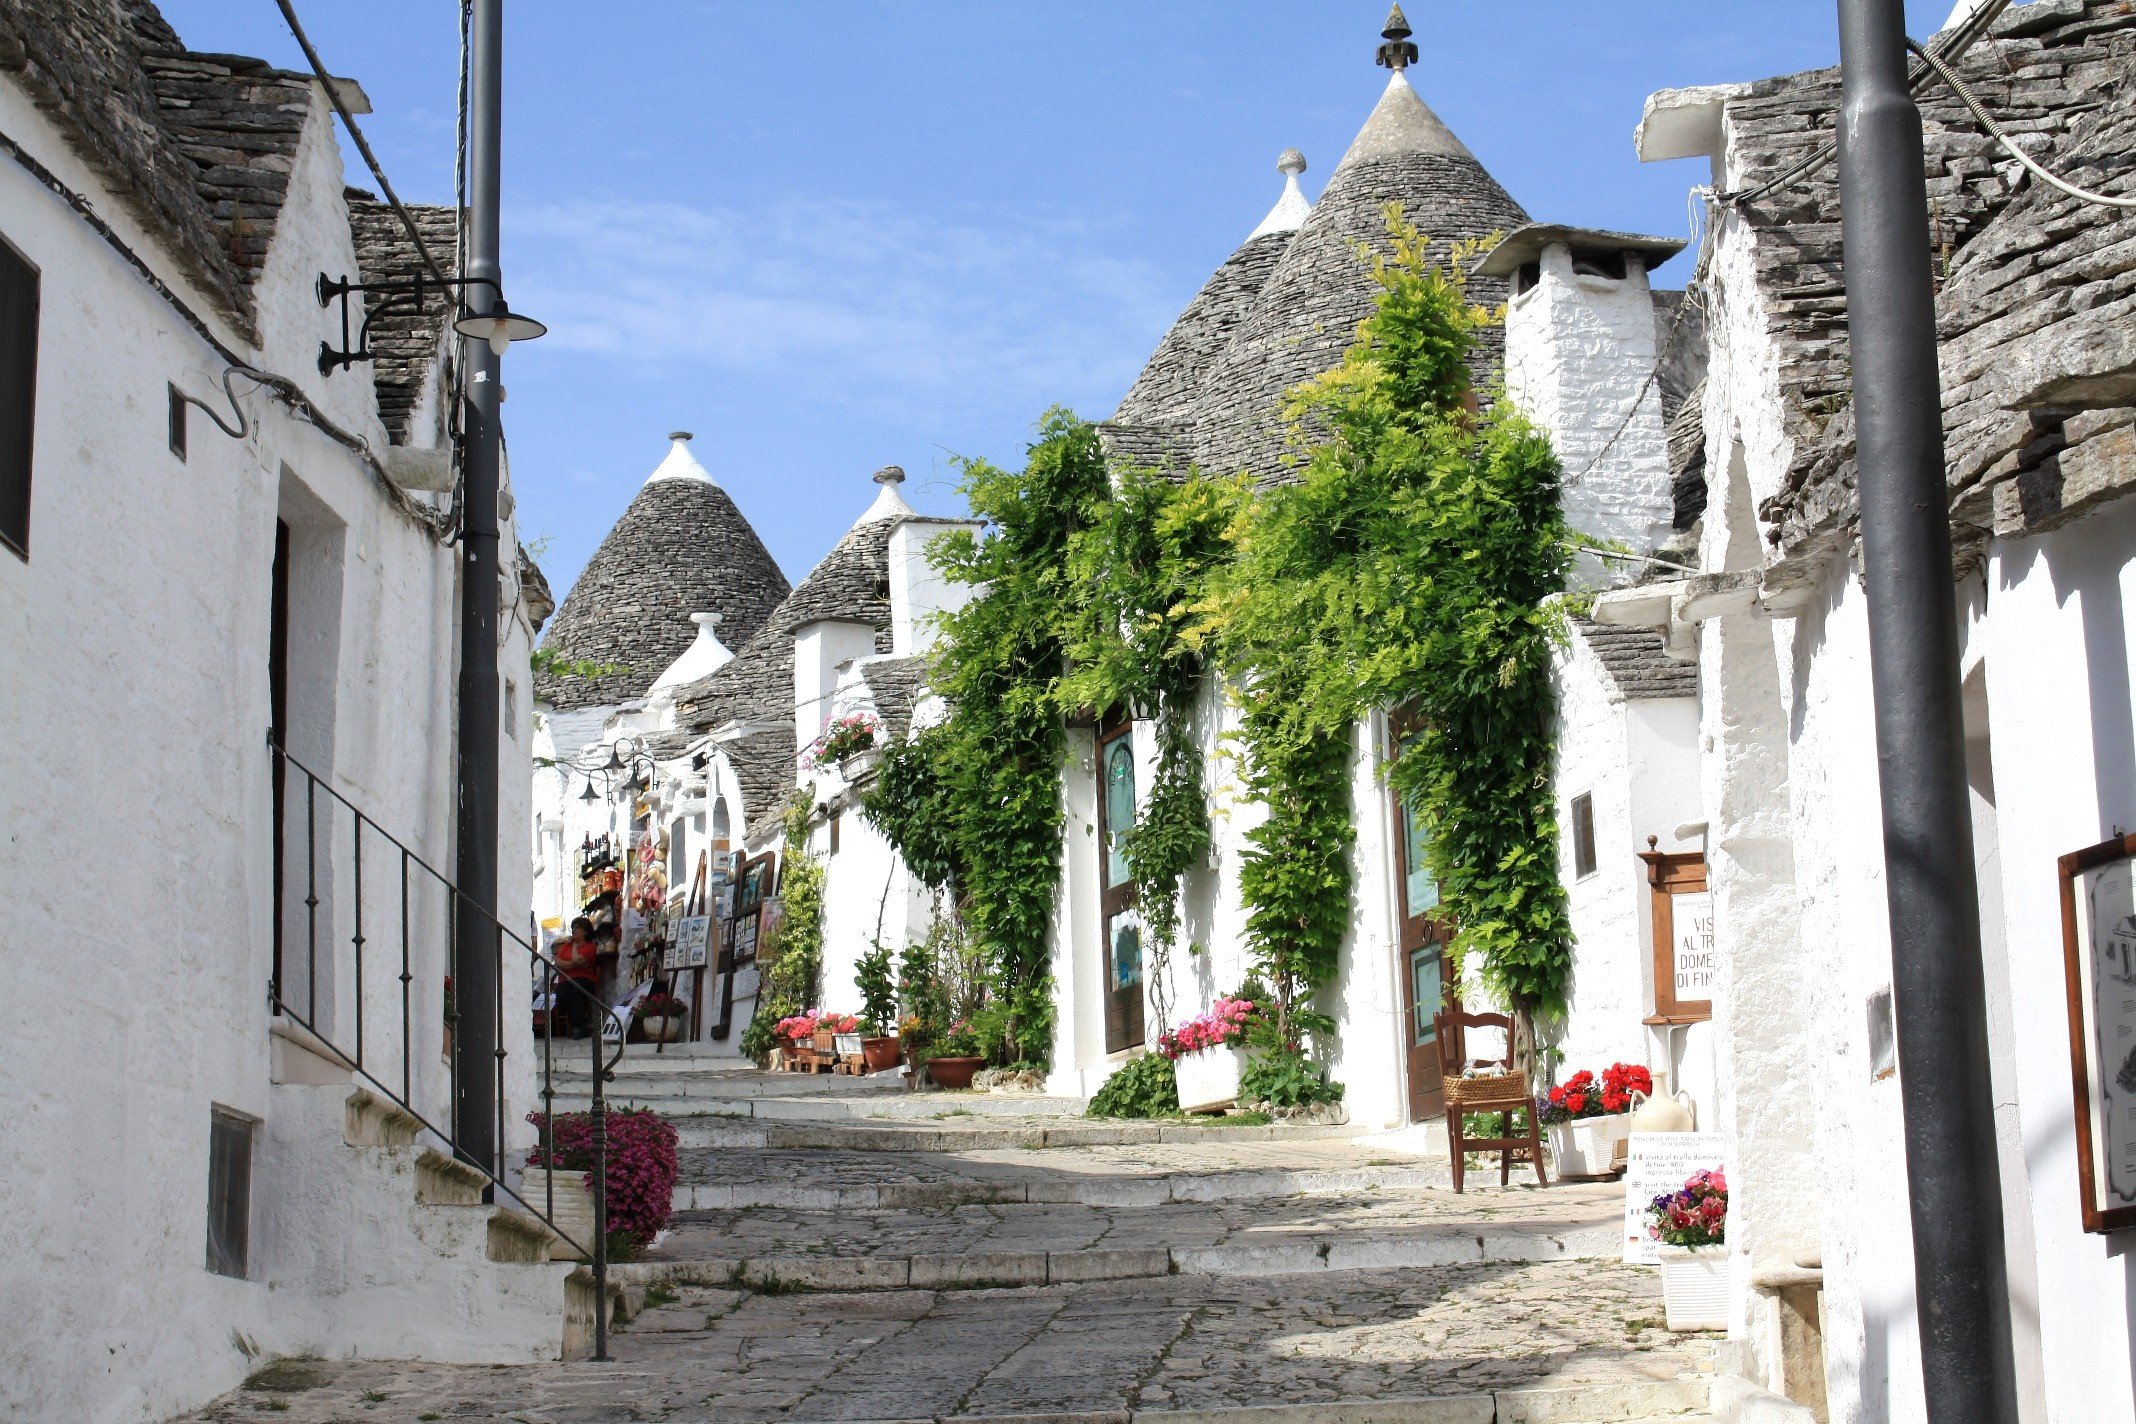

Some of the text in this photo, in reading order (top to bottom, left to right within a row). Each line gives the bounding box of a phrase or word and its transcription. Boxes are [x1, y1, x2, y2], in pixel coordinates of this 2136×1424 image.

[1694, 916, 1714, 932] VIS
[1682, 935, 1697, 951] AL
[1680, 952, 1714, 970] DOME
[1677, 973, 1689, 988] DI
